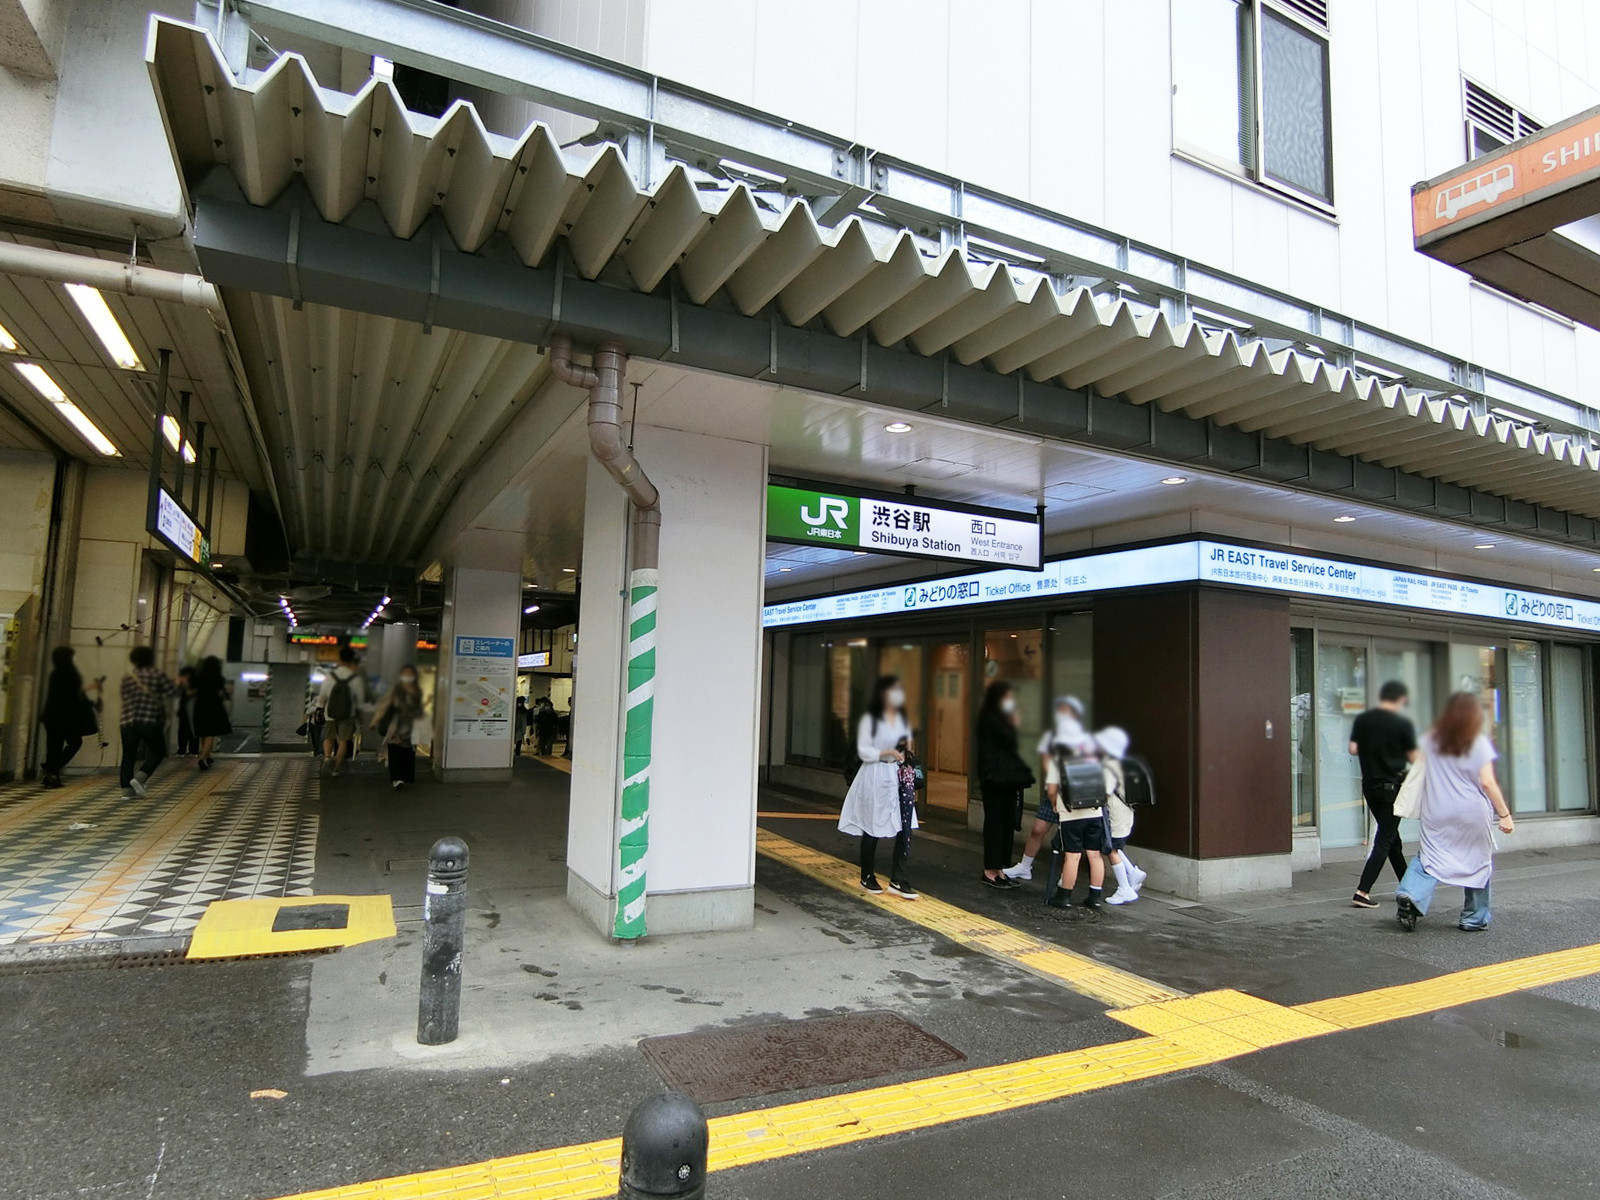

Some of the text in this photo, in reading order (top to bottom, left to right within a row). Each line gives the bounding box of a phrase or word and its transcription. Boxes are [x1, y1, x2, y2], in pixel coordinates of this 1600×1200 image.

[800, 496, 849, 530] JR
[872, 505, 931, 533] 渋谷駅
[806, 527, 843, 539] JR東日本
[971, 519, 997, 537] 西口
[871, 530, 961, 553] Shibuya Station
[971, 537, 1024, 552] West Entrance
[1210, 548, 1357, 581] JR EAST Travel Service Center
[918, 580, 980, 603] みどりの窓口
[985, 584, 1007, 597] Ticket
[1008, 582, 1032, 595] Office
[764, 603, 817, 617] EAST Travel Service Center
[1521, 597, 1574, 621] みどりの窓口
